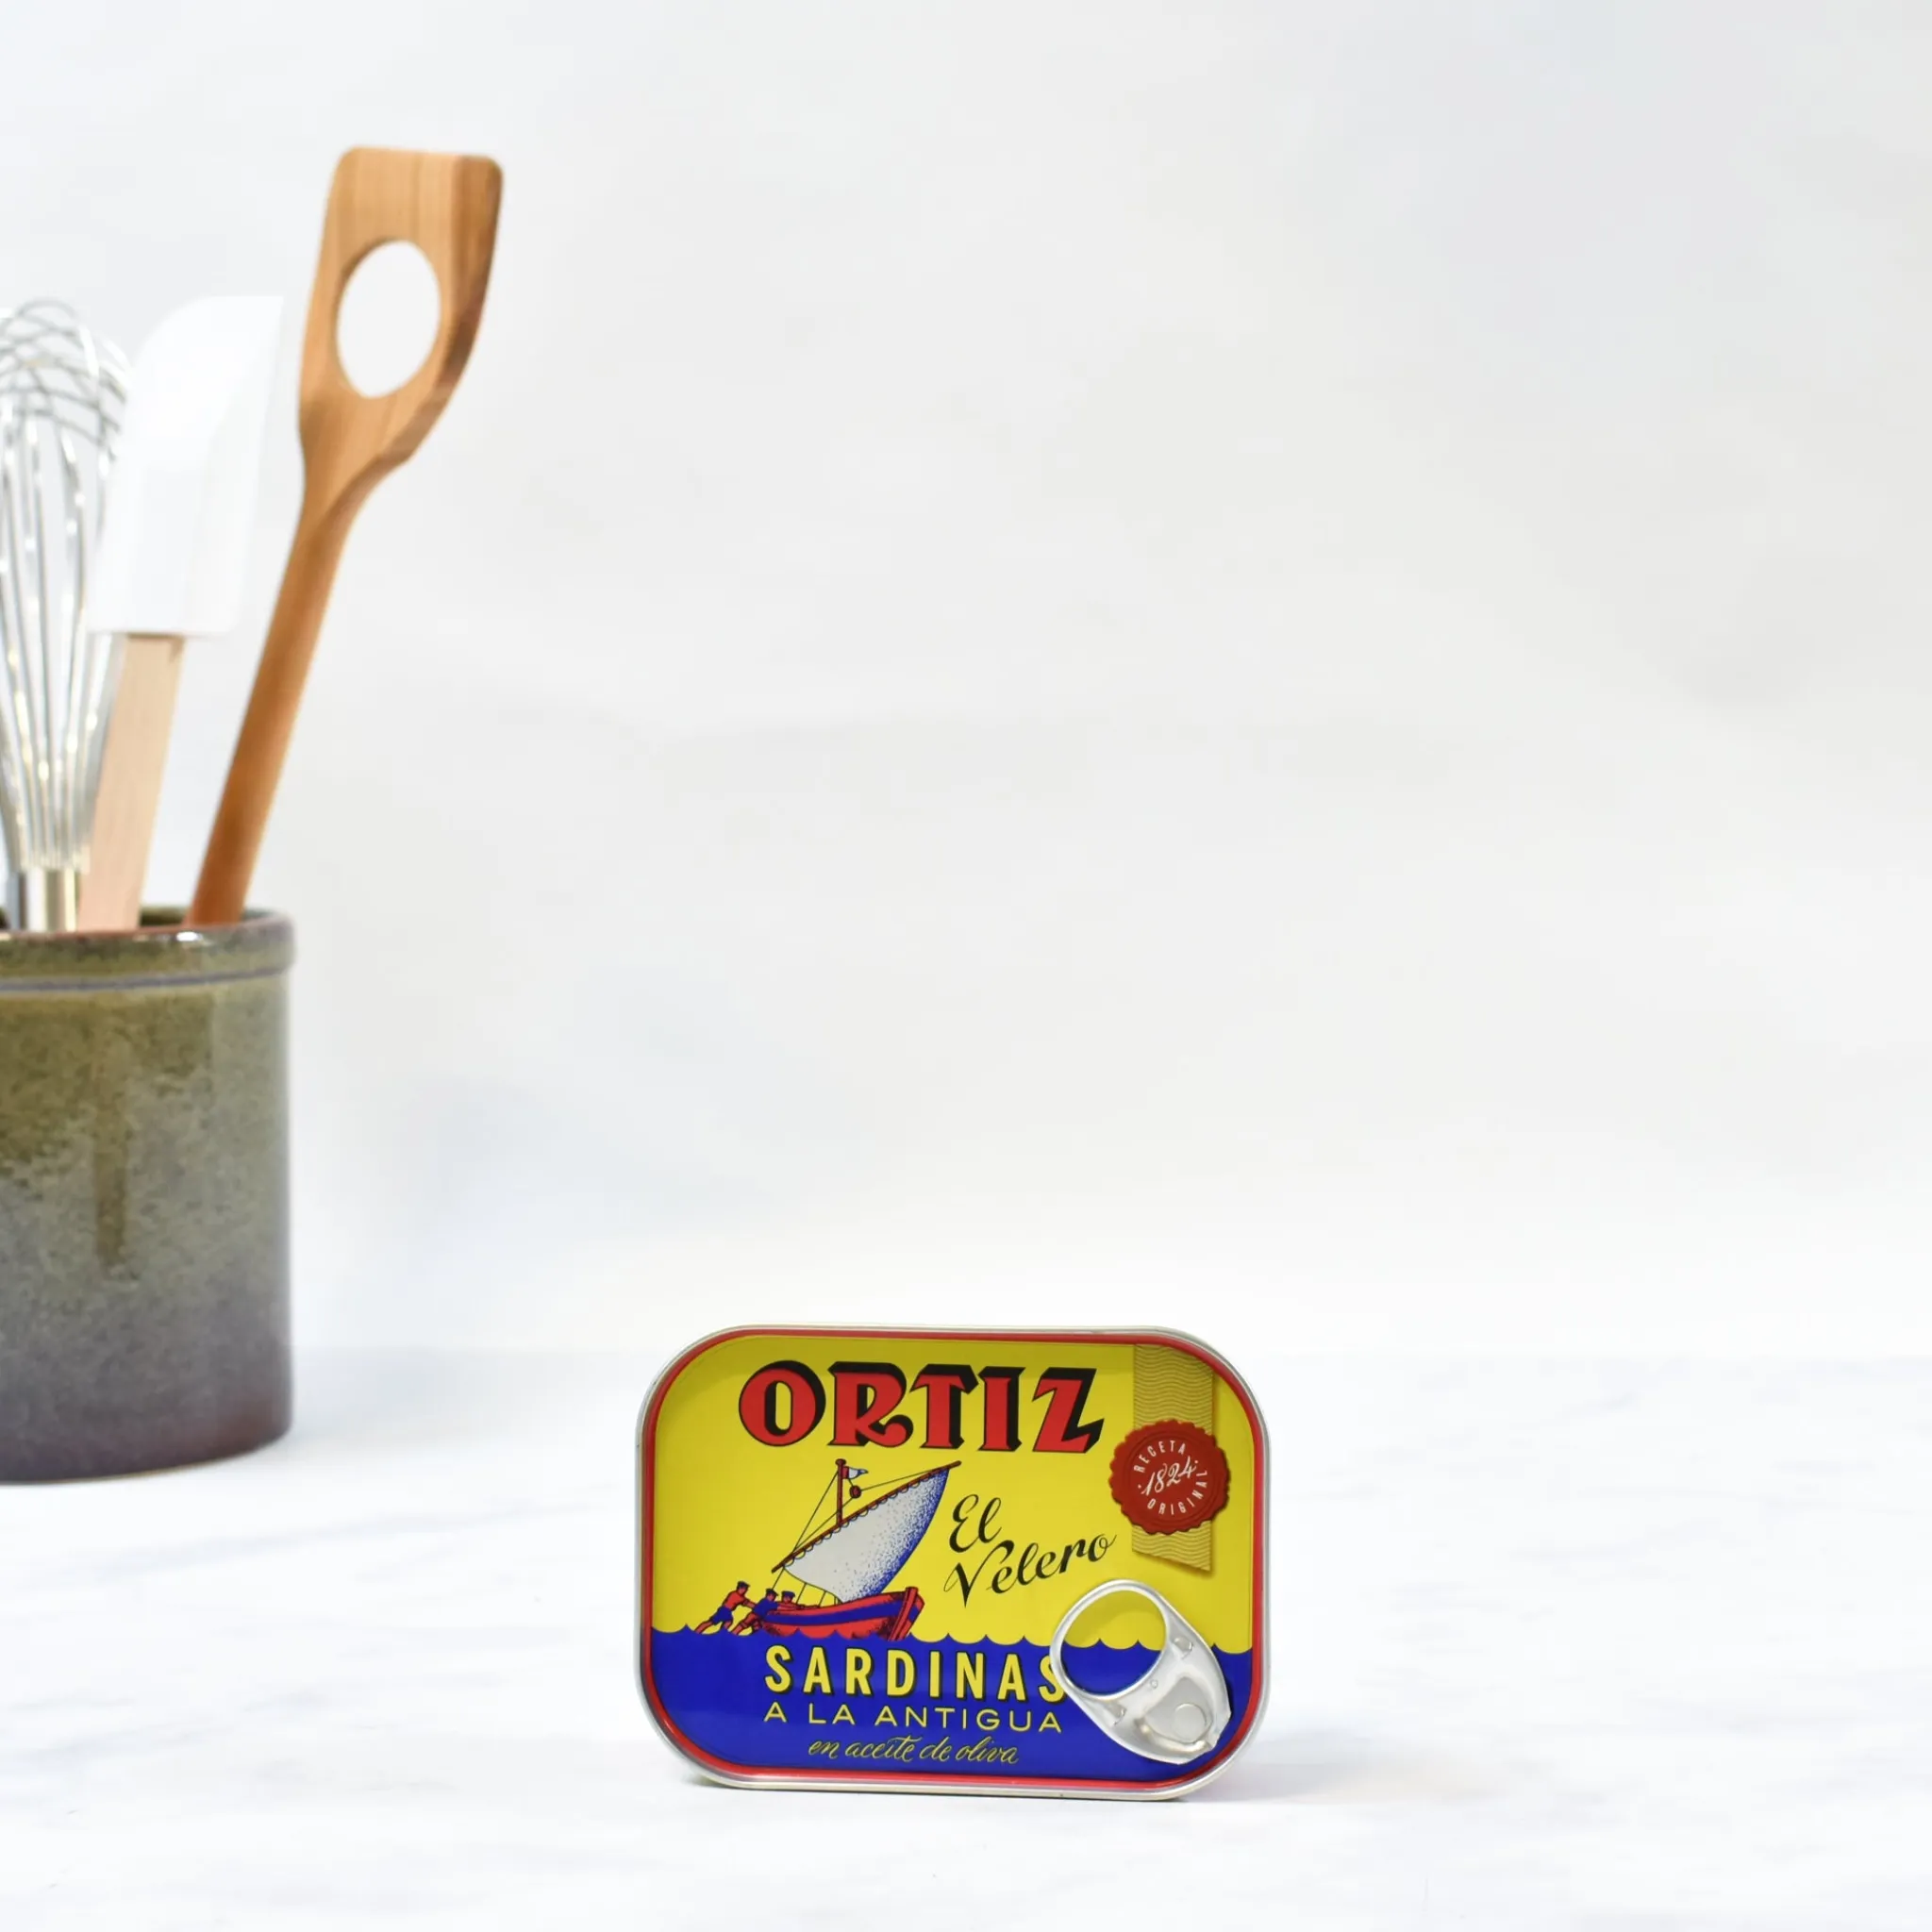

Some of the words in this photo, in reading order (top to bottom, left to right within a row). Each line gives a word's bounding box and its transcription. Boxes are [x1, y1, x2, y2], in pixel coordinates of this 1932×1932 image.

[739, 1359, 1105, 1454] ORTIZ
[1133, 1440, 1186, 1473] RECETA
[1146, 1470, 1208, 1515] ORIGINAL
[950, 1493, 1002, 1553] El
[943, 1533, 1117, 1607] Velero
[764, 1645, 1065, 1702] SARDINAS
[763, 1702, 788, 1723] A
[808, 1703, 855, 1725] LA
[874, 1705, 1062, 1733] ANTIGUA
[808, 1739, 842, 1759] en
[844, 1734, 923, 1763] aceite
[919, 1736, 951, 1763] de
[955, 1736, 1020, 1765] oliva
